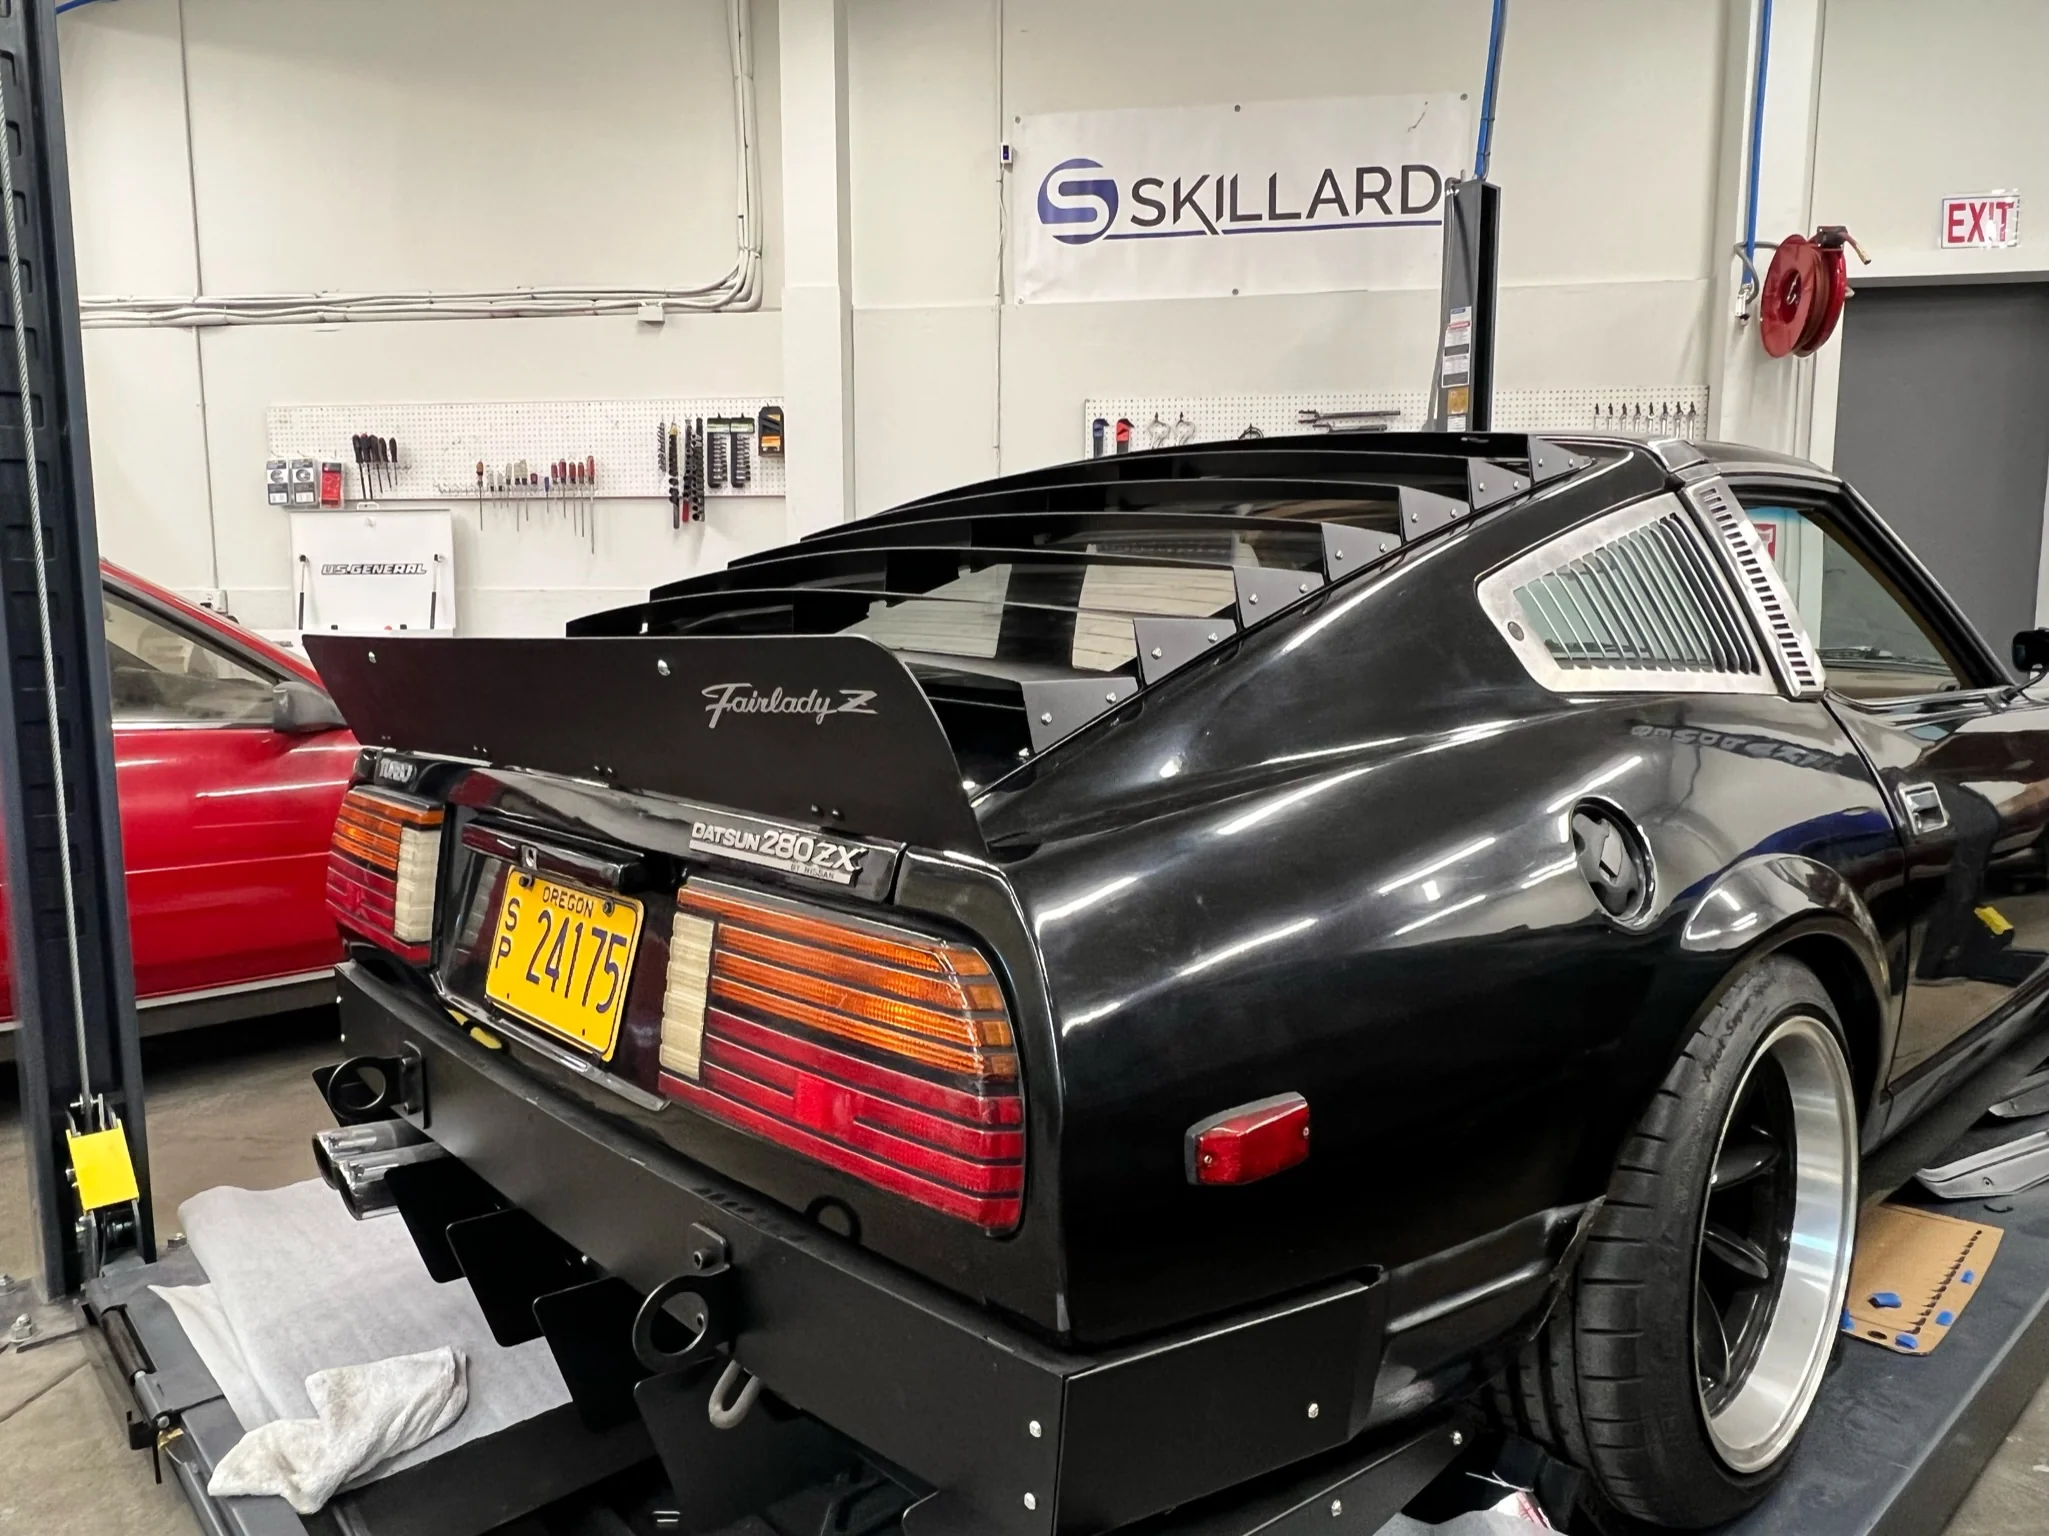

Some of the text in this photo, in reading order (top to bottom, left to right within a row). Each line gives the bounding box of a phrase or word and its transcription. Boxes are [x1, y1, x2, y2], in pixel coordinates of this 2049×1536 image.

[1130, 164, 1442, 235] SKILLARD
[1947, 201, 2015, 243] EXIT
[701, 682, 878, 729] Fairlady Z
[691, 821, 868, 871] DATSUN 280ZX
[804, 866, 835, 880] NISSAN
[542, 886, 594, 919] OREGON
[525, 909, 628, 1014] 24175
